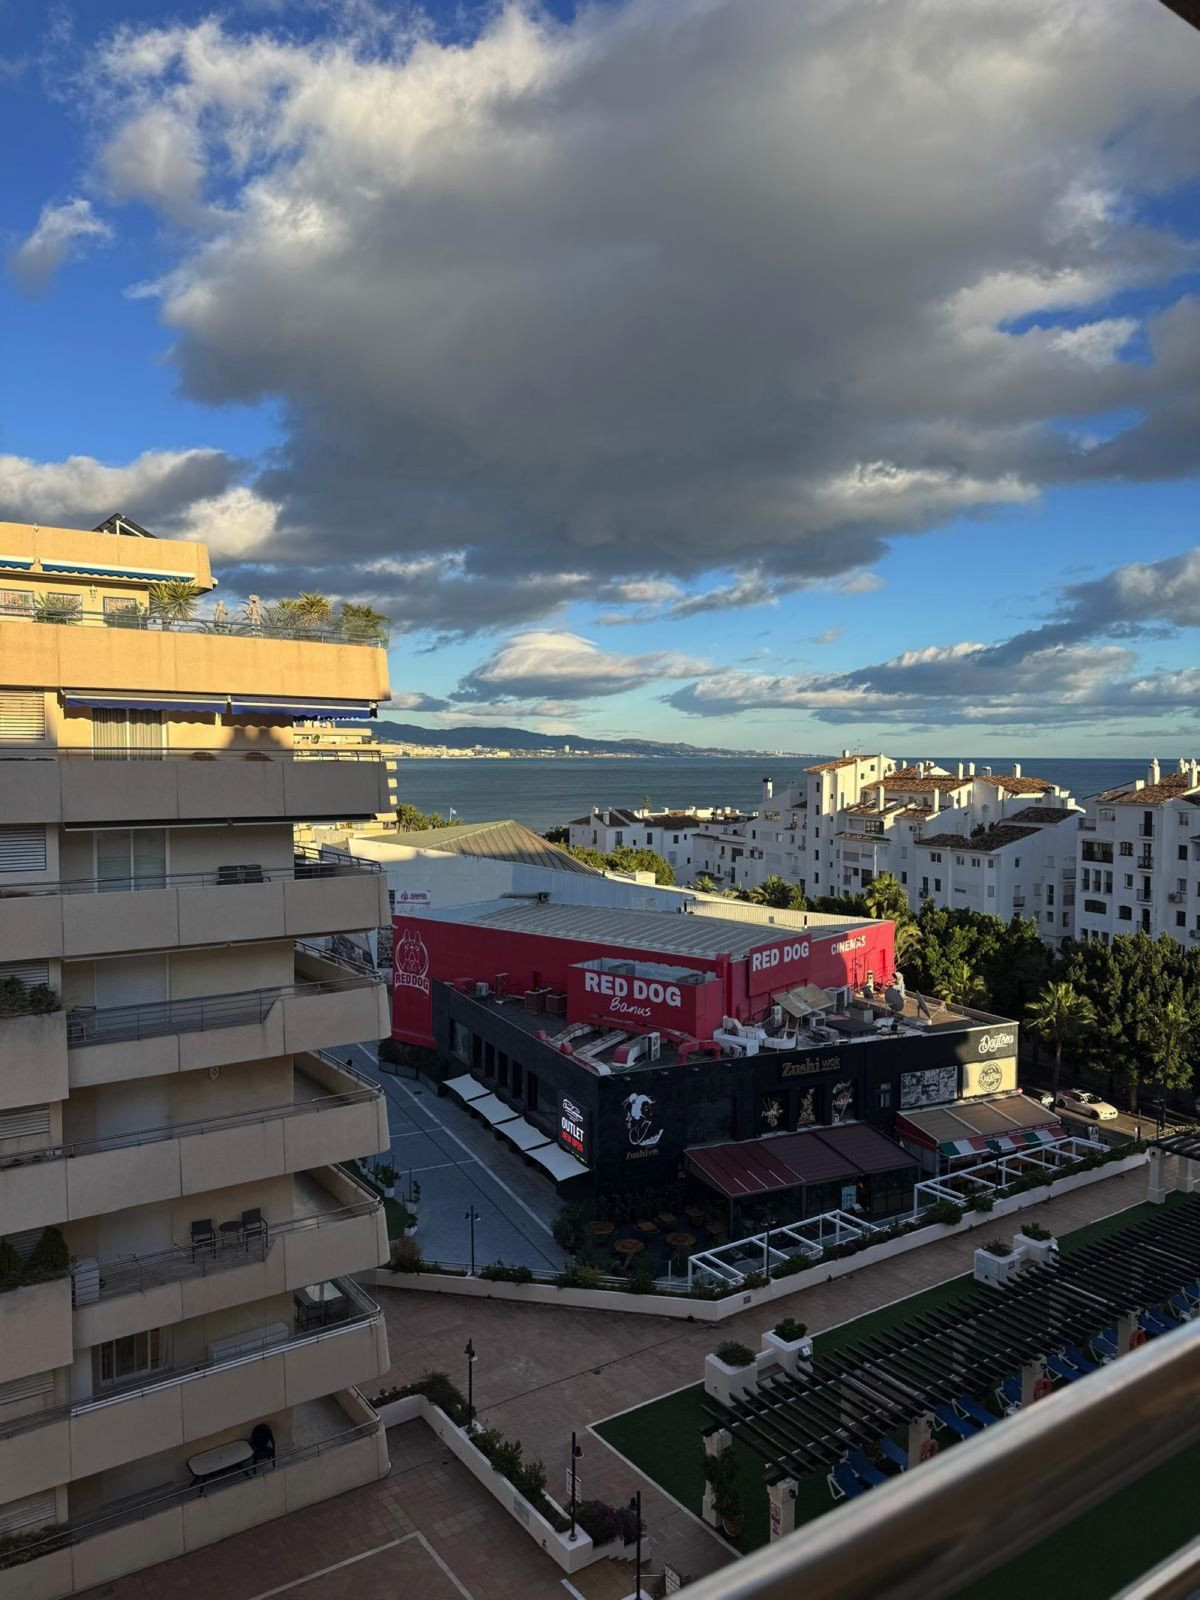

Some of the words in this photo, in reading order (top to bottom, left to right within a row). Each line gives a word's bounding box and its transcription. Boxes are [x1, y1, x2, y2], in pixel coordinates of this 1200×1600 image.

[831, 935, 866, 955] CINEMAS
[752, 949, 779, 972] RED
[784, 941, 809, 963] DOG
[585, 971, 628, 997] RED
[633, 980, 681, 1007] DOG
[610, 997, 651, 1016] Banus
[978, 1033, 1014, 1053] Daytona
[782, 1057, 820, 1077] Zushi
[561, 1116, 584, 1143] OUTLET
